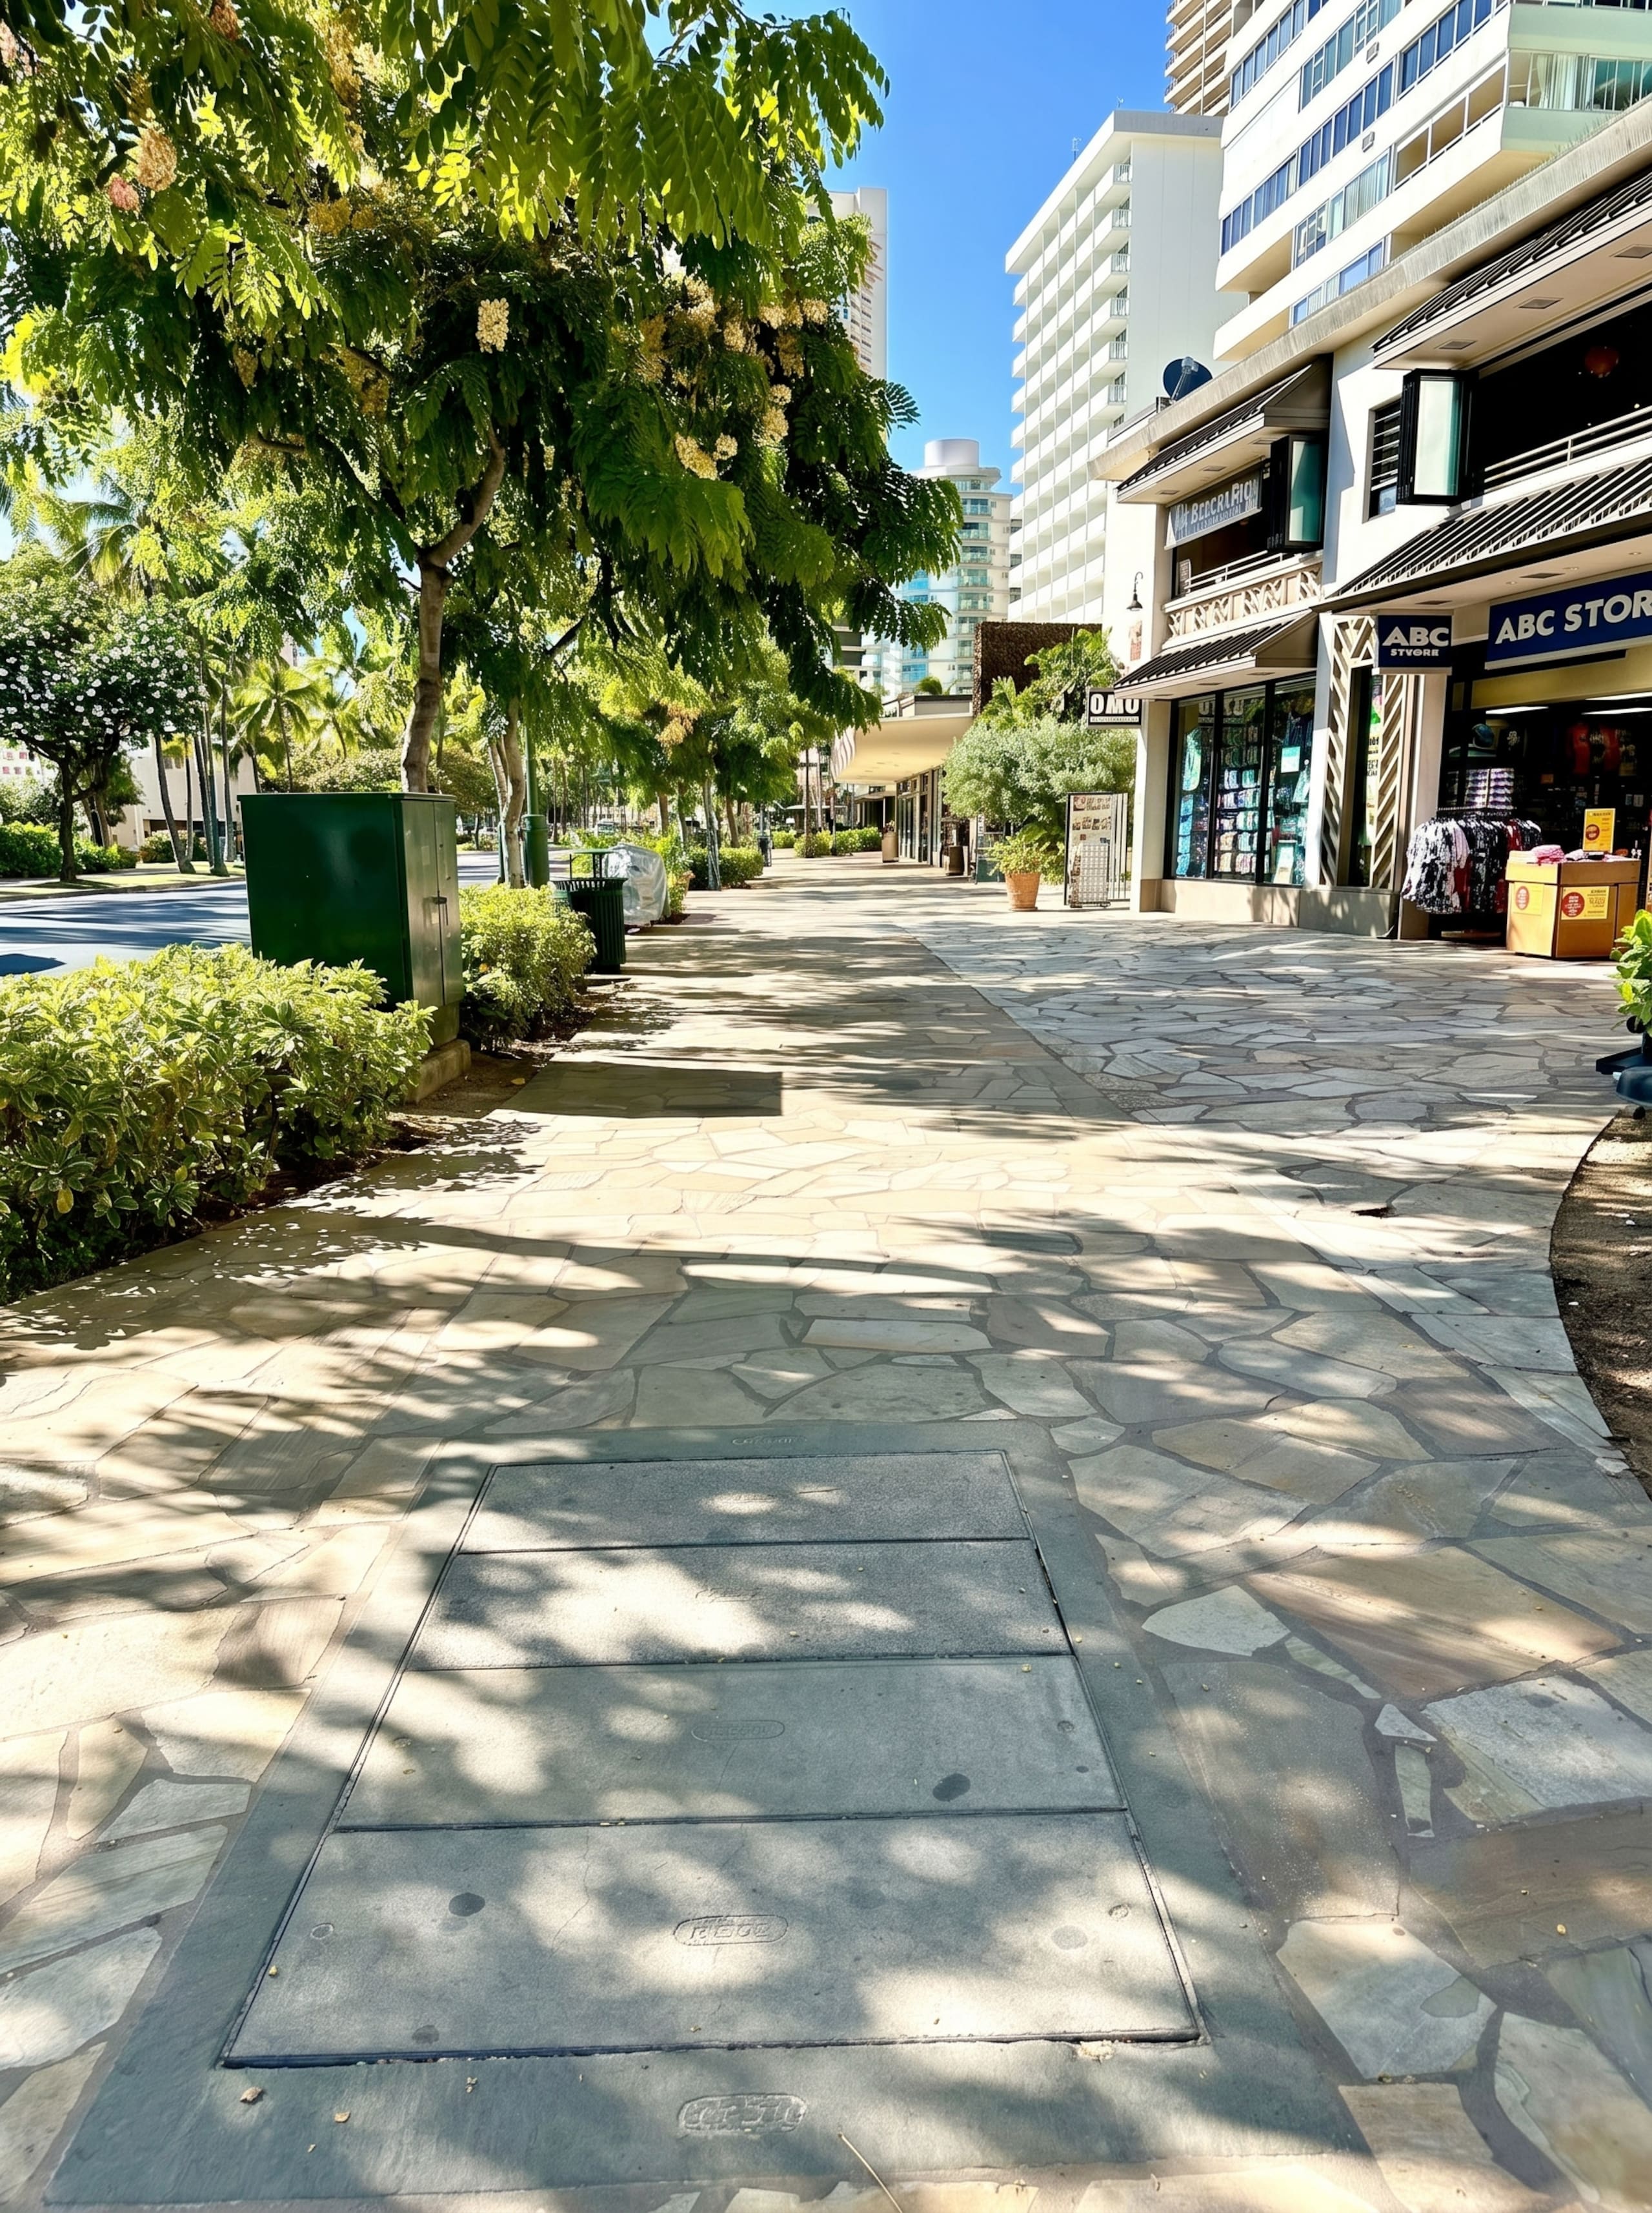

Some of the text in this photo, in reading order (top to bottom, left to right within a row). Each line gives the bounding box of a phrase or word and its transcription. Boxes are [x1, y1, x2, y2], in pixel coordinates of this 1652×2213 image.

[1495, 590, 1652, 644] ABC STOR
[1382, 626, 1449, 647] ABC
